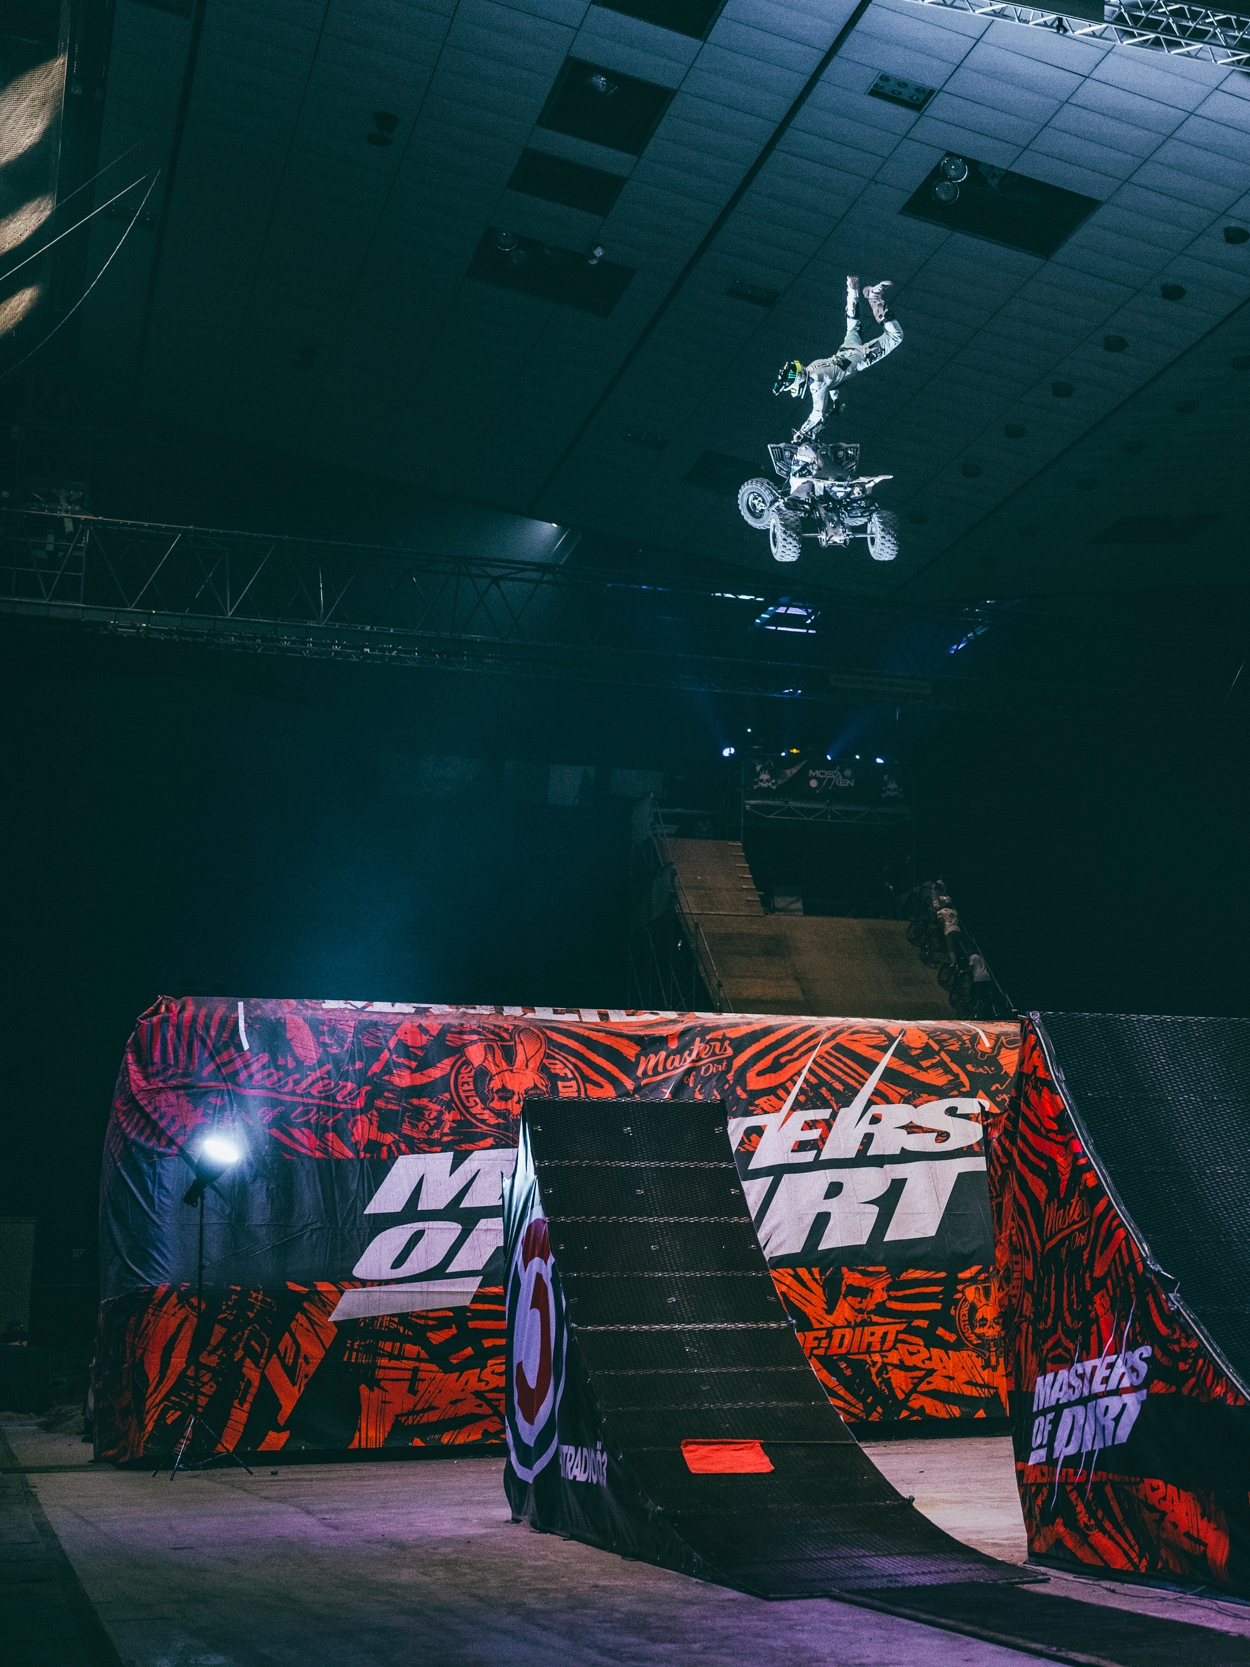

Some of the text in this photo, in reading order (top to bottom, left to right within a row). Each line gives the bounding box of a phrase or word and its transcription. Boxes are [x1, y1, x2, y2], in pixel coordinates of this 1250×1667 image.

[202, 1047, 372, 1108] Masters
[636, 1036, 734, 1078] Masters
[683, 1059, 728, 1088] of Dirt
[257, 1105, 344, 1126] of Dirt
[827, 1323, 907, 1355] DIRT
[1032, 1345, 1152, 1413] MASTERS
[1031, 1389, 1147, 1459] OF DIRT
